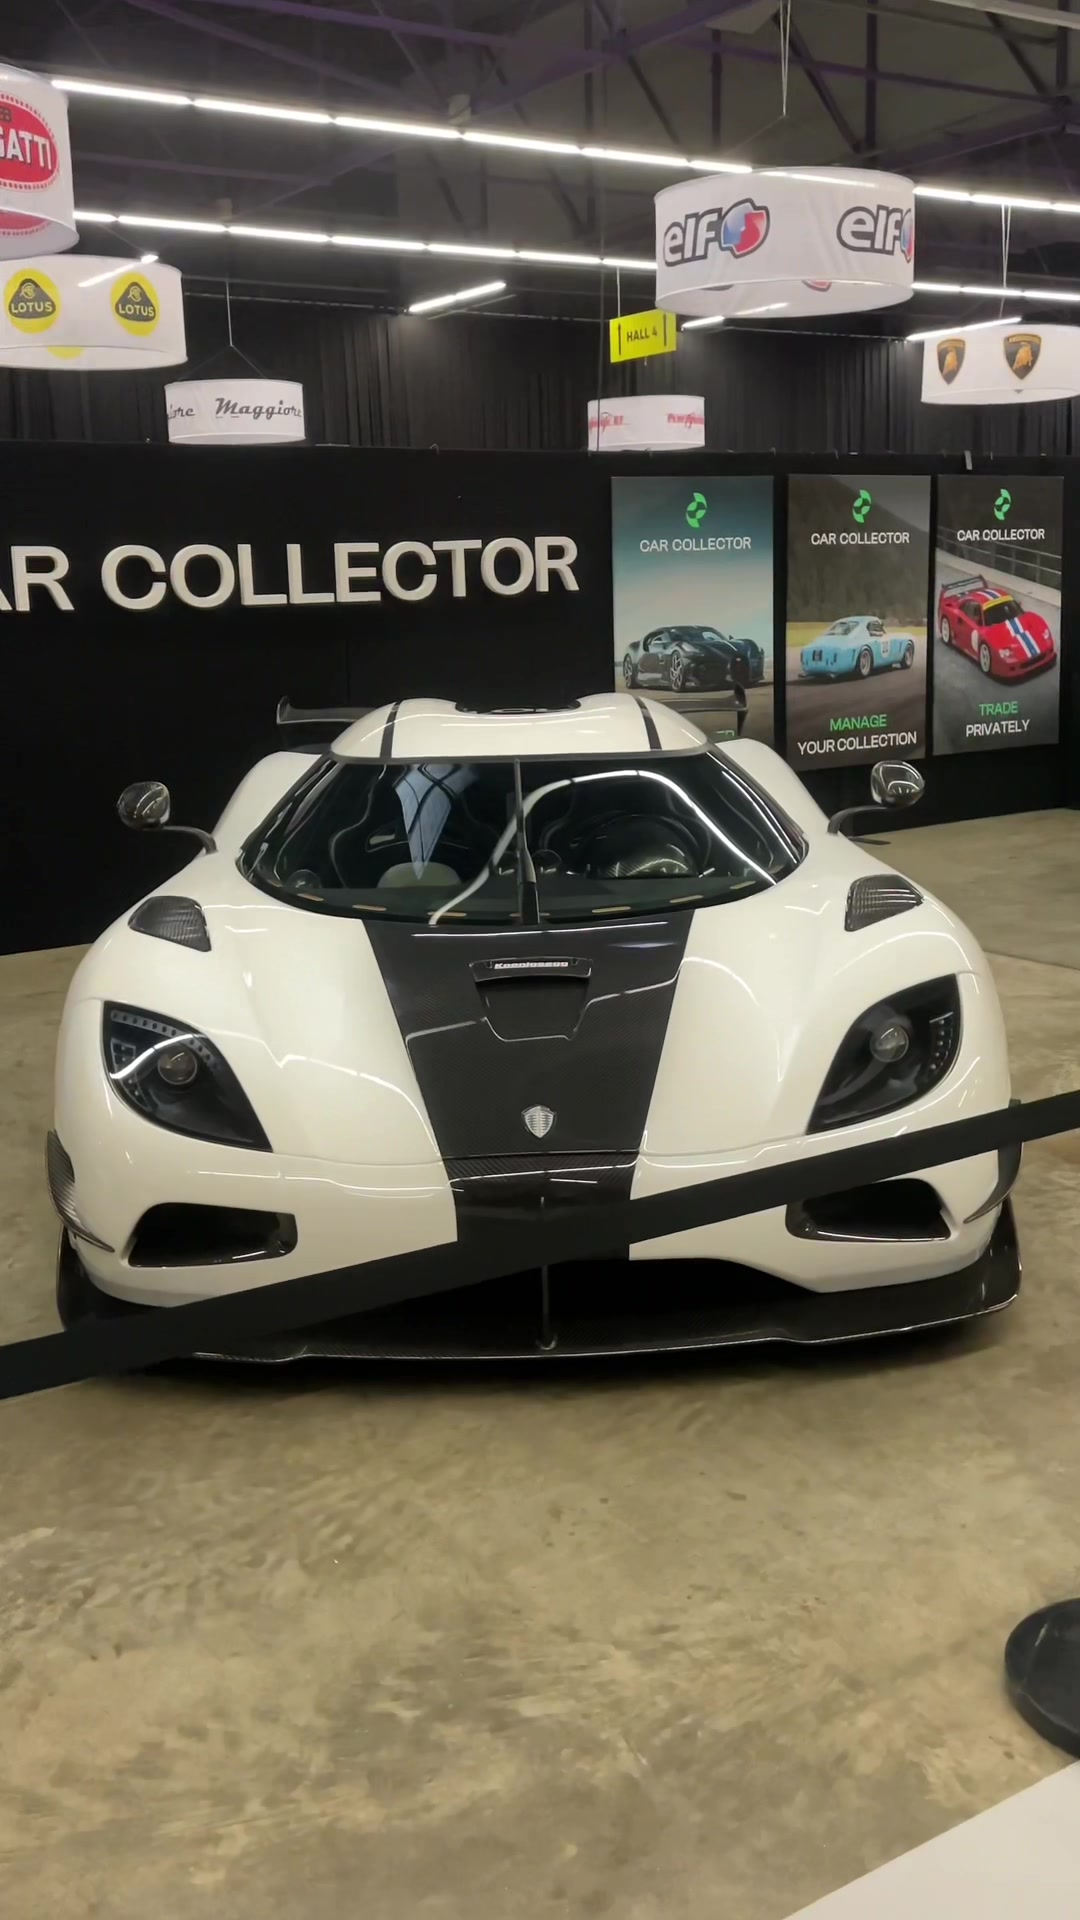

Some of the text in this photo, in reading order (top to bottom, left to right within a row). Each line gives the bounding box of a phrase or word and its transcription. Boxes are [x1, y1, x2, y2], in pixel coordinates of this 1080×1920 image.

[11, 301, 53, 313] LOTUS
[118, 304, 155, 317] LOTUS
[627, 325, 657, 342] HALL 4
[811, 532, 910, 545] CAR COLLECTOR
[957, 528, 1045, 541] CAR COLLECTOR
[640, 536, 752, 552] CAR COLLECTOR
[0, 536, 579, 612] R COLLECTOR
[979, 701, 1019, 716] TRADE
[829, 714, 887, 731] MANAGE
[966, 719, 1031, 737] PRIVATELY
[797, 731, 918, 755] YOUR COLLECTION
